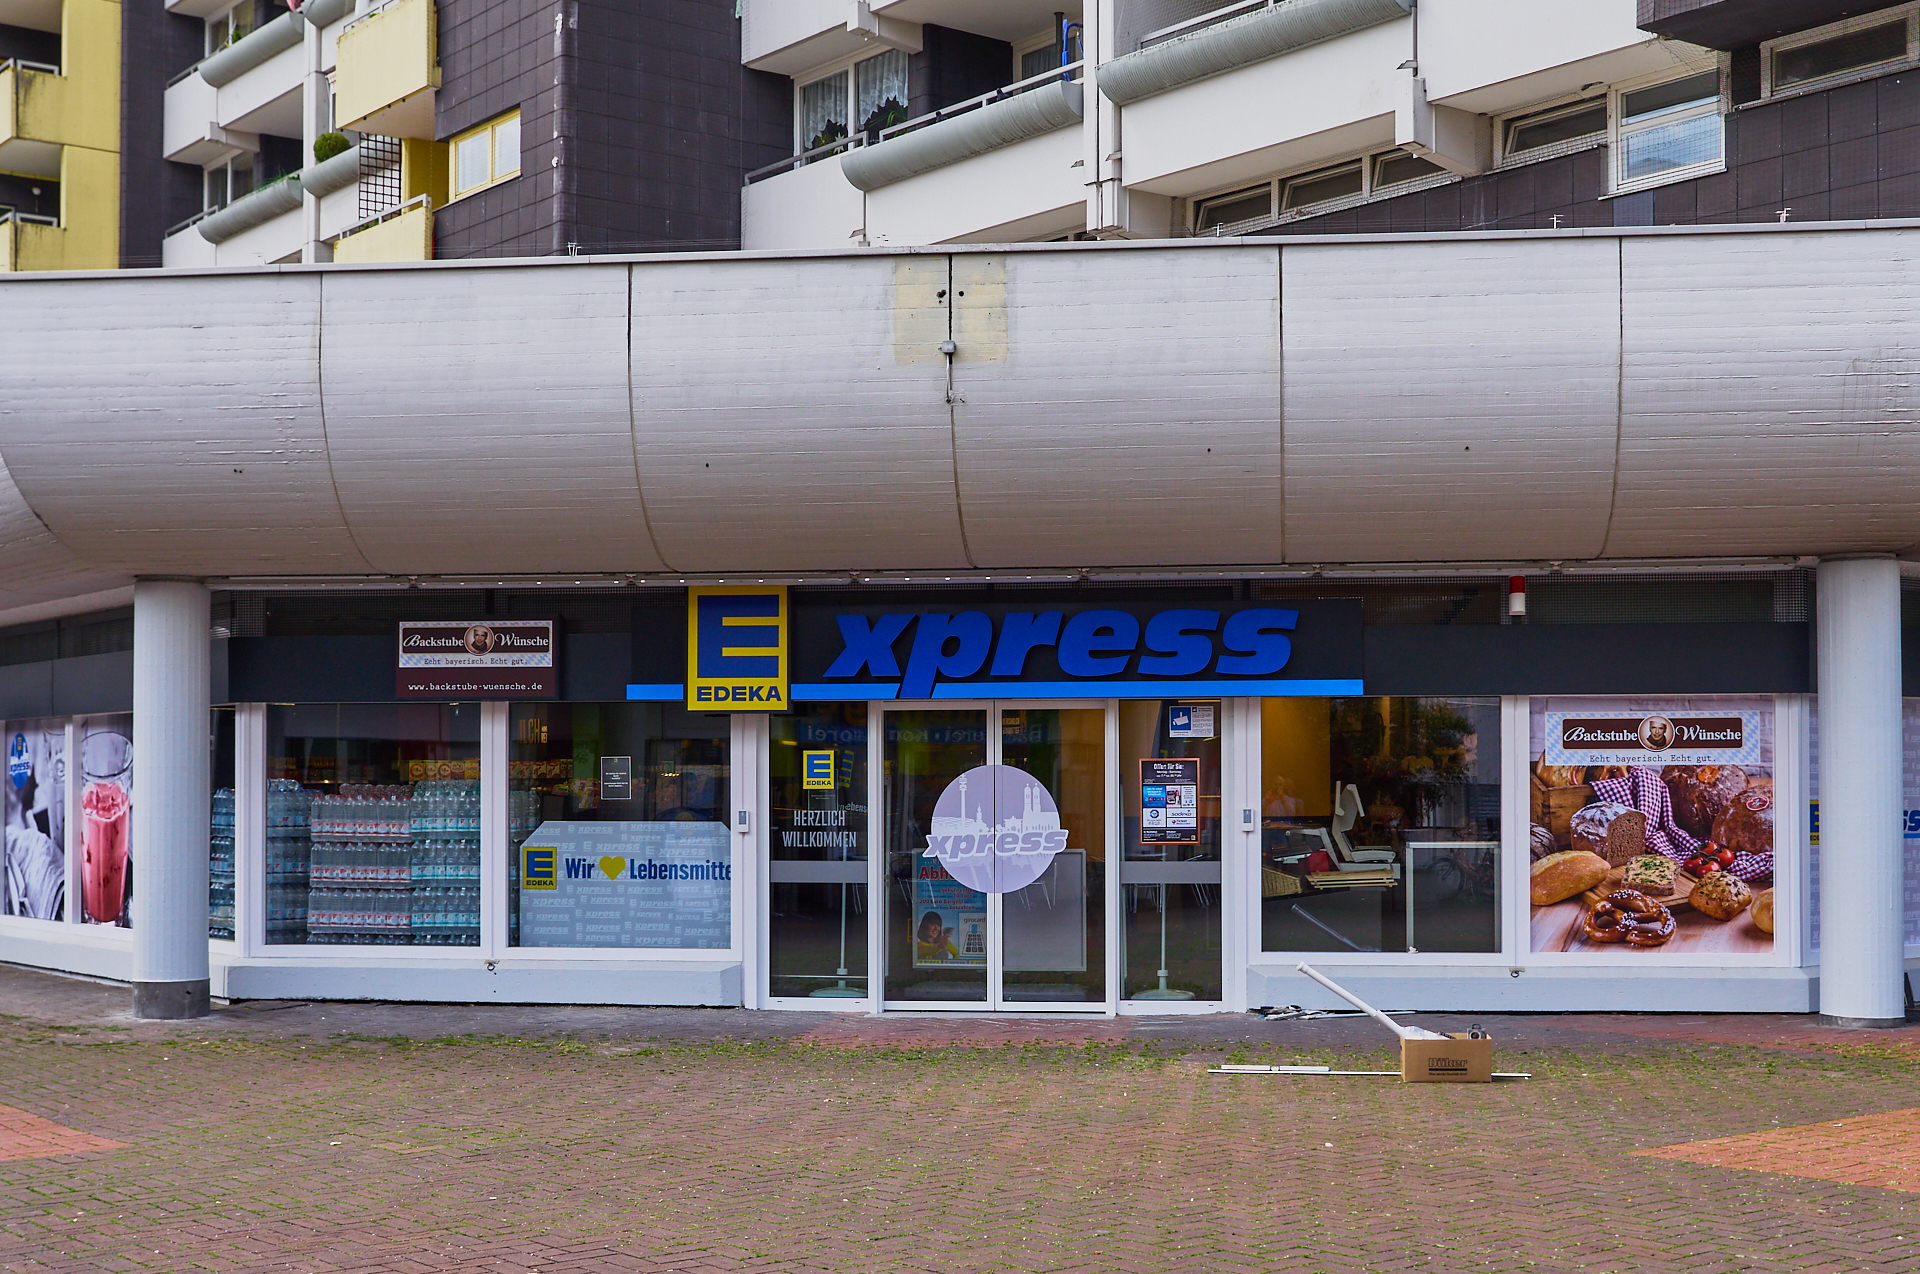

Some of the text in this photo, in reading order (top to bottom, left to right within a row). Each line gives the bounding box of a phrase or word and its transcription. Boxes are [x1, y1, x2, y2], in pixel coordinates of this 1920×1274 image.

[403, 632, 549, 647] Backstube Wünsche
[823, 608, 1300, 698] xpress
[445, 658, 488, 667] bayerisch.
[511, 658, 528, 667] gut.
[408, 682, 543, 691] www.backstube-wuensche.de
[696, 685, 782, 702] EDEKA
[1564, 725, 1742, 742] Backstube Wünsche
[1589, 754, 1717, 765] Echt bayerisch. Echt gut.
[793, 810, 846, 827] HERZLICH
[781, 831, 857, 848] WILLKOMMEN
[923, 831, 1067, 860] xpress
[565, 858, 595, 879] Wir
[1428, 1057, 1468, 1067] Düker
